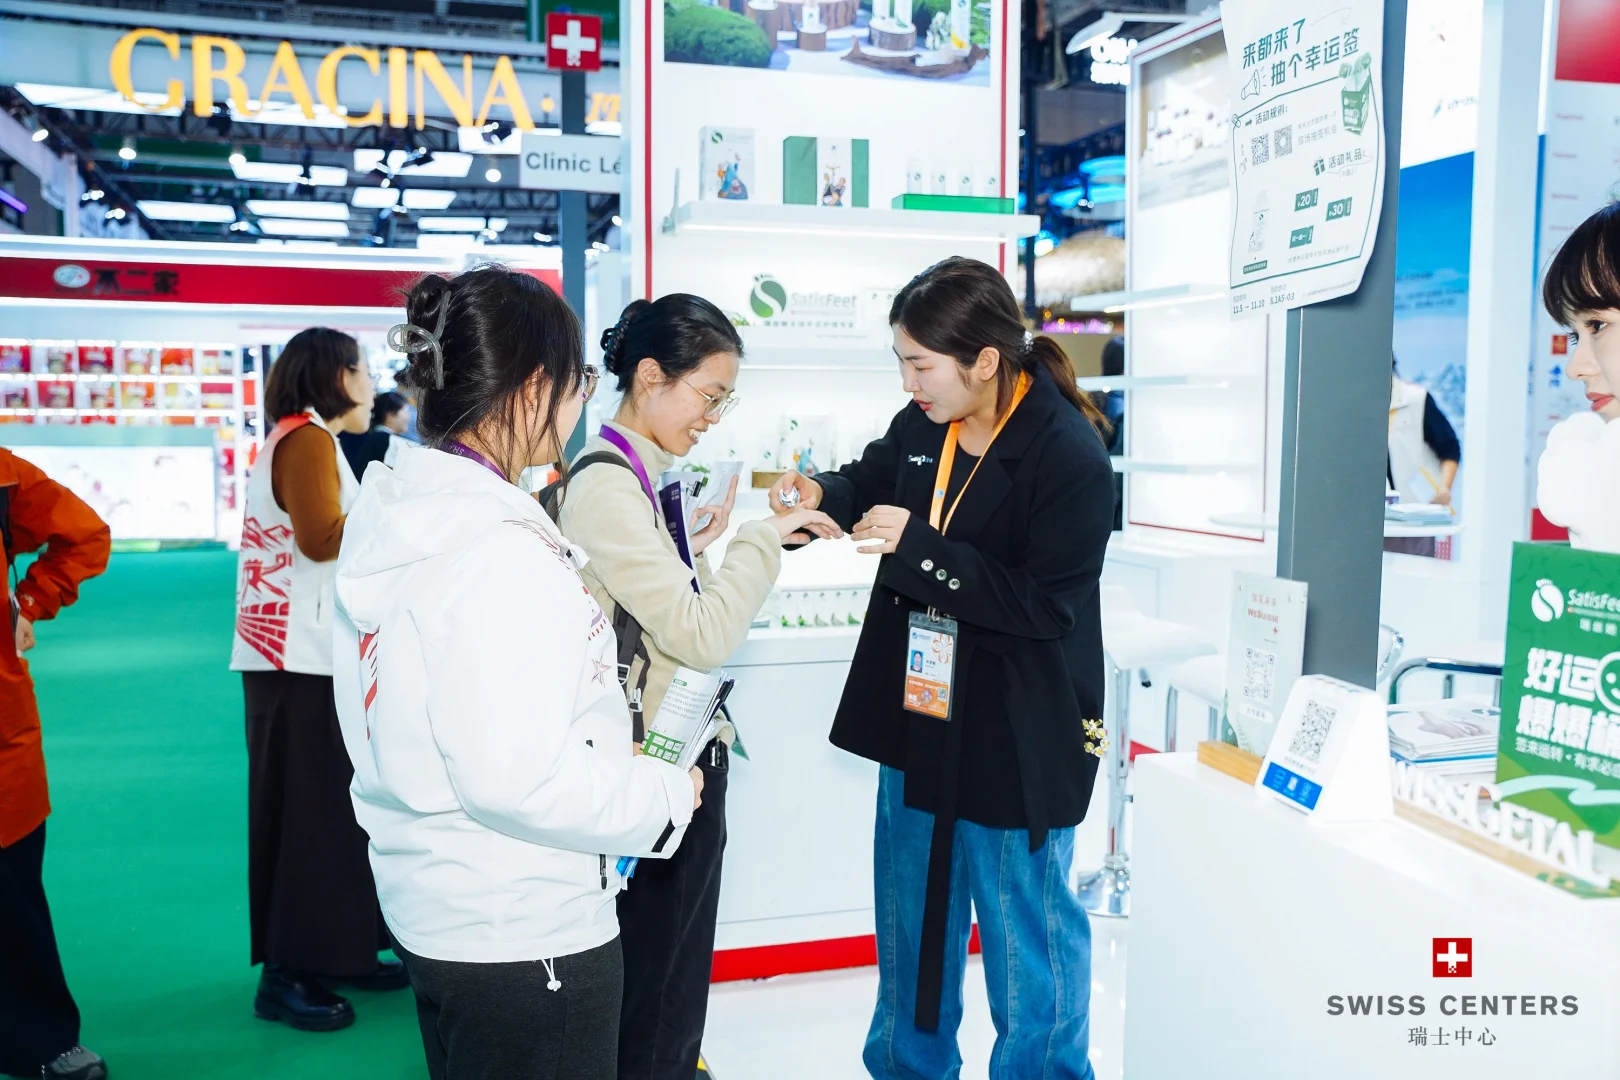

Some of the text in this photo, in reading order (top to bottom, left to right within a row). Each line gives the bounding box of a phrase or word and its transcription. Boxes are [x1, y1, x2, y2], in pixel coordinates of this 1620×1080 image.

[1242, 18, 1306, 70] 来都来了
[1270, 28, 1360, 87] 抽个幸运签
[110, 27, 536, 131] GRACINA
[526, 152, 591, 173] Clinic
[92, 267, 180, 295] 不二家
[790, 291, 858, 309] SatisFeet
[1522, 647, 1600, 702] 好运
